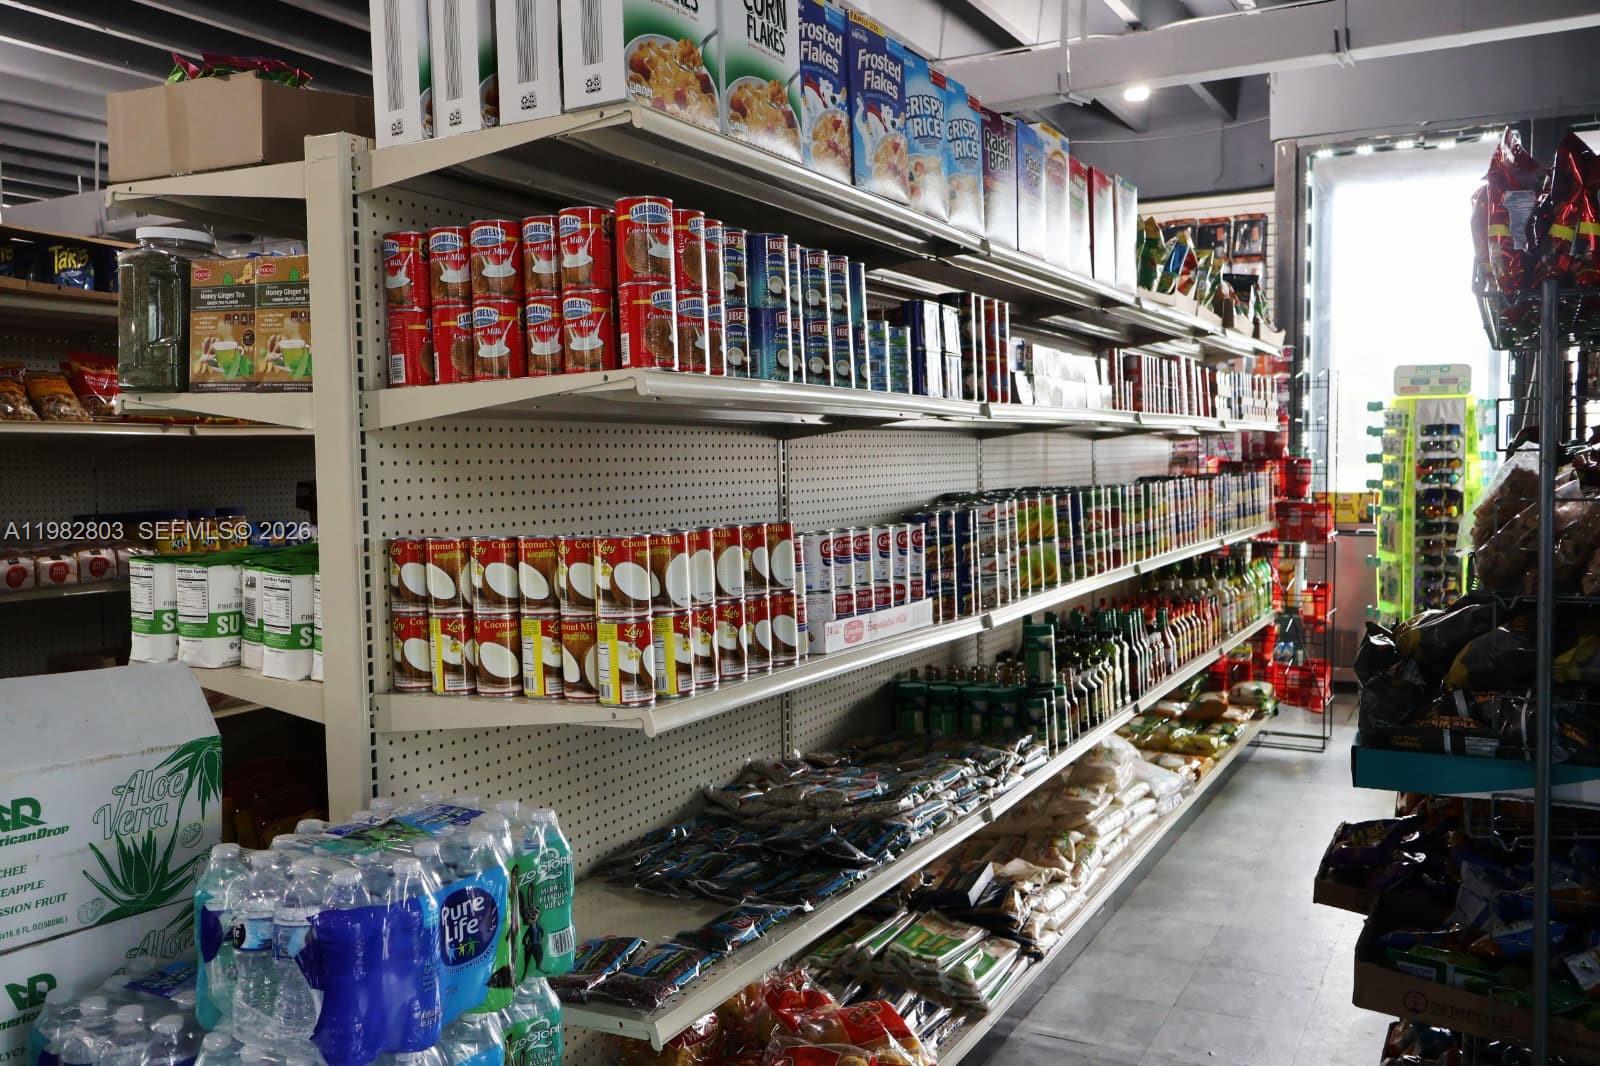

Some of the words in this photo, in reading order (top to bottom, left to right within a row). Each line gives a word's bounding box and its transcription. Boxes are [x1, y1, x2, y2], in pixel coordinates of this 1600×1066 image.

[747, 14, 785, 57] FLAKES
[800, 41, 839, 75] Flakes
[858, 49, 902, 84] Frosted
[863, 70, 898, 101] Flakes
[913, 117, 942, 140] RICE
[954, 140, 978, 161] RICE
[984, 128, 1012, 158] Raisin
[988, 151, 1010, 173] Bran
[200, 292, 216, 301] Honey
[217, 291, 235, 300] Ginger
[446, 619, 467, 633] Loty
[624, 624, 645, 639] Loty
[111, 769, 184, 806] Aloe
[92, 803, 168, 840] Vera
[35, 892, 69, 909] FRUIT
[440, 895, 485, 927] Pure
[444, 916, 479, 943] Life
